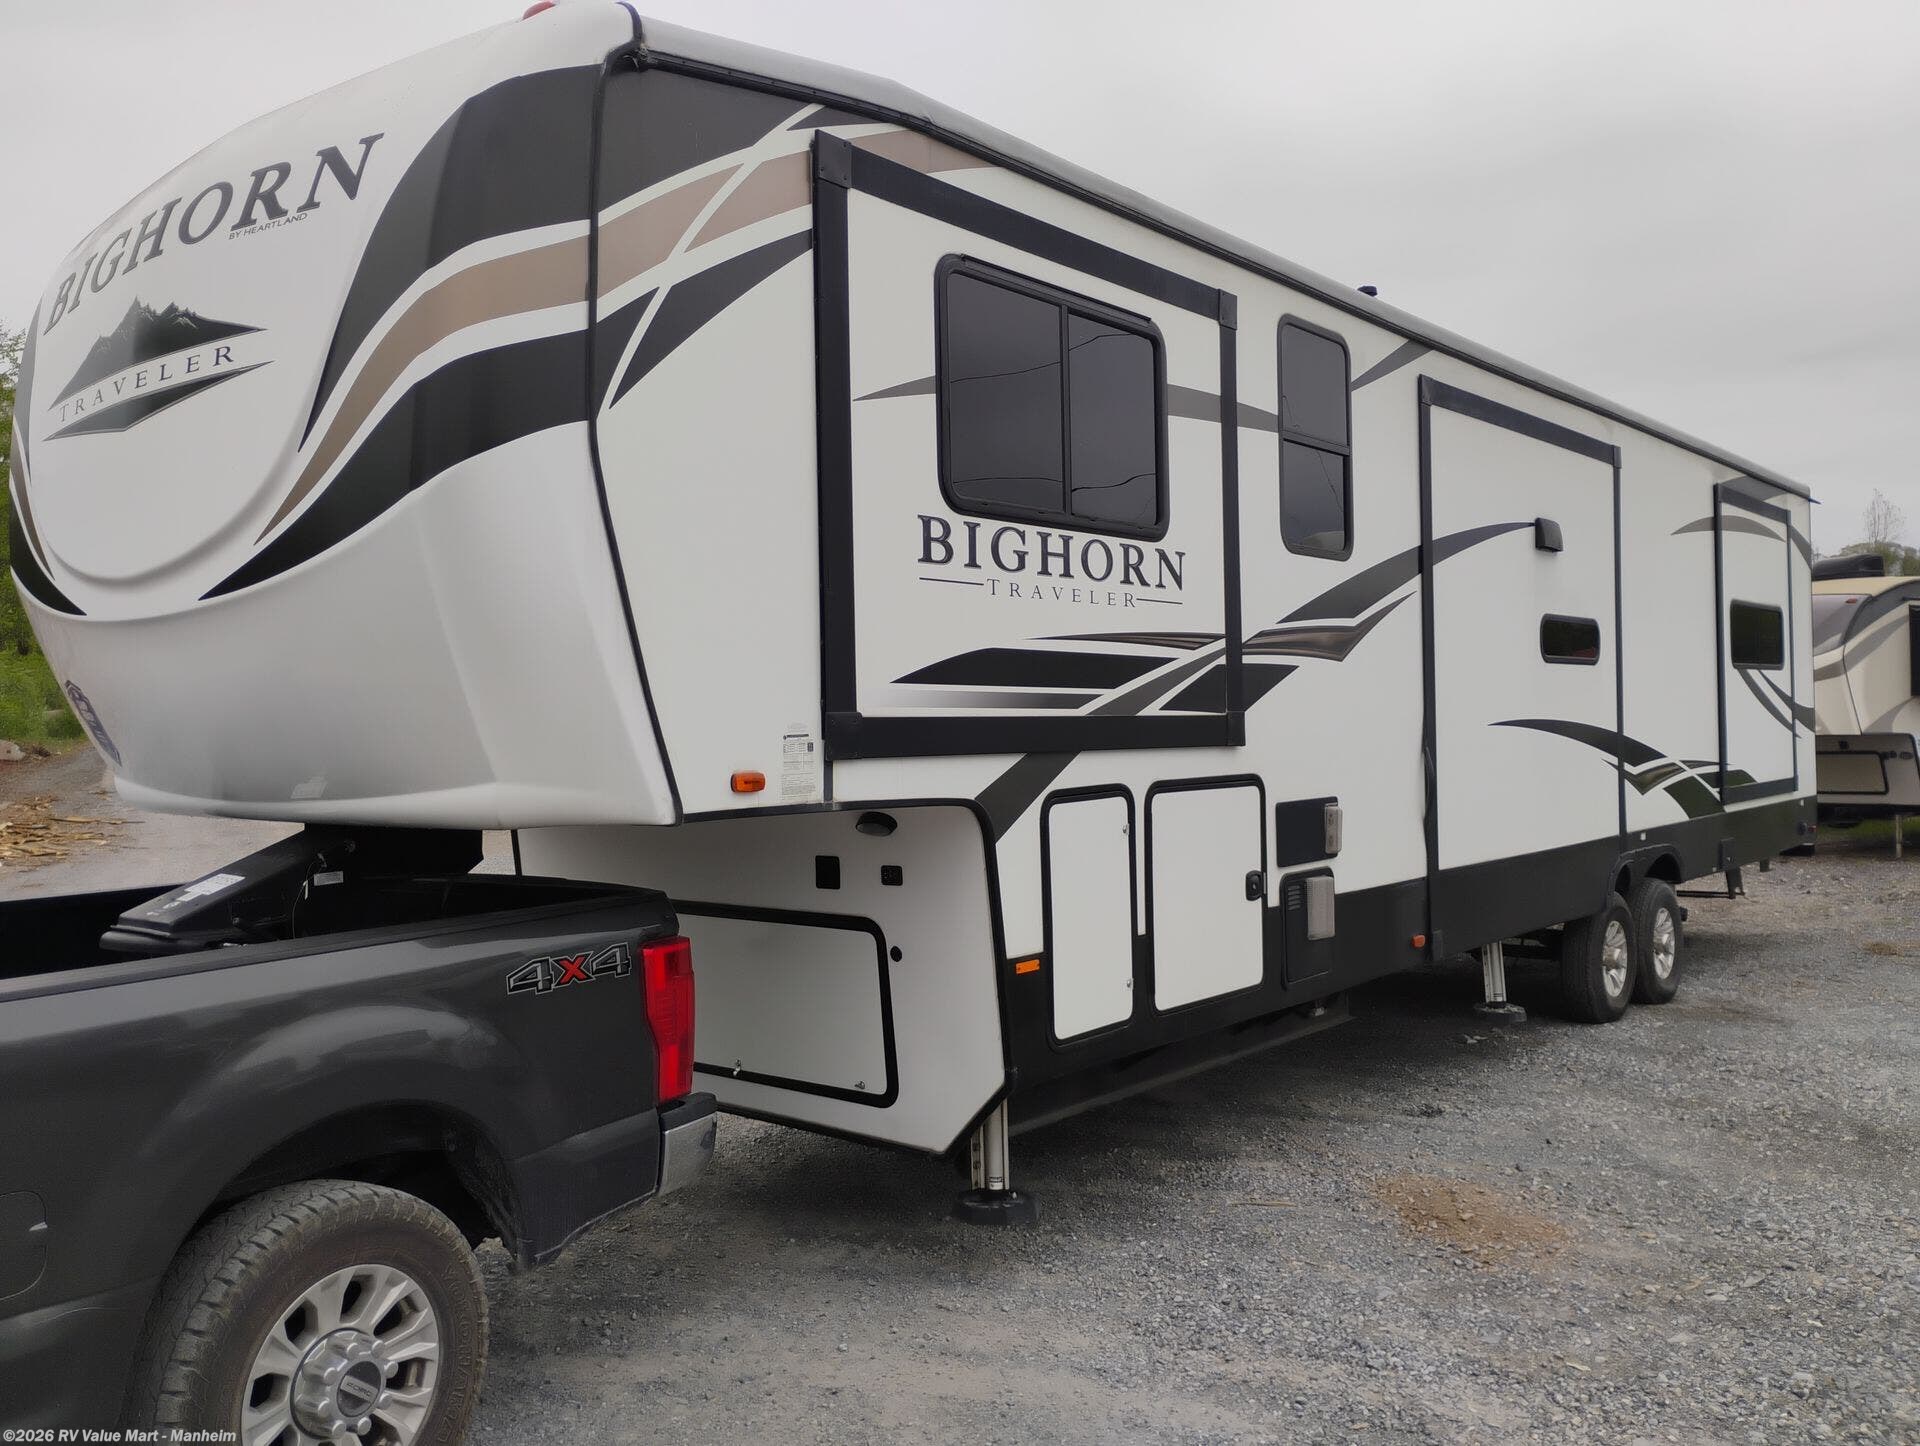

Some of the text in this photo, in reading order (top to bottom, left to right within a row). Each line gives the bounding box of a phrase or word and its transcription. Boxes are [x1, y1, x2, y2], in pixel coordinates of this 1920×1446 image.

[43, 132, 385, 336] BIGHORN
[229, 212, 308, 240] BY HEARTLAND
[58, 345, 234, 423] TRAVELER
[917, 514, 1186, 591] BIGHORN
[986, 578, 1136, 608] TRAVELER
